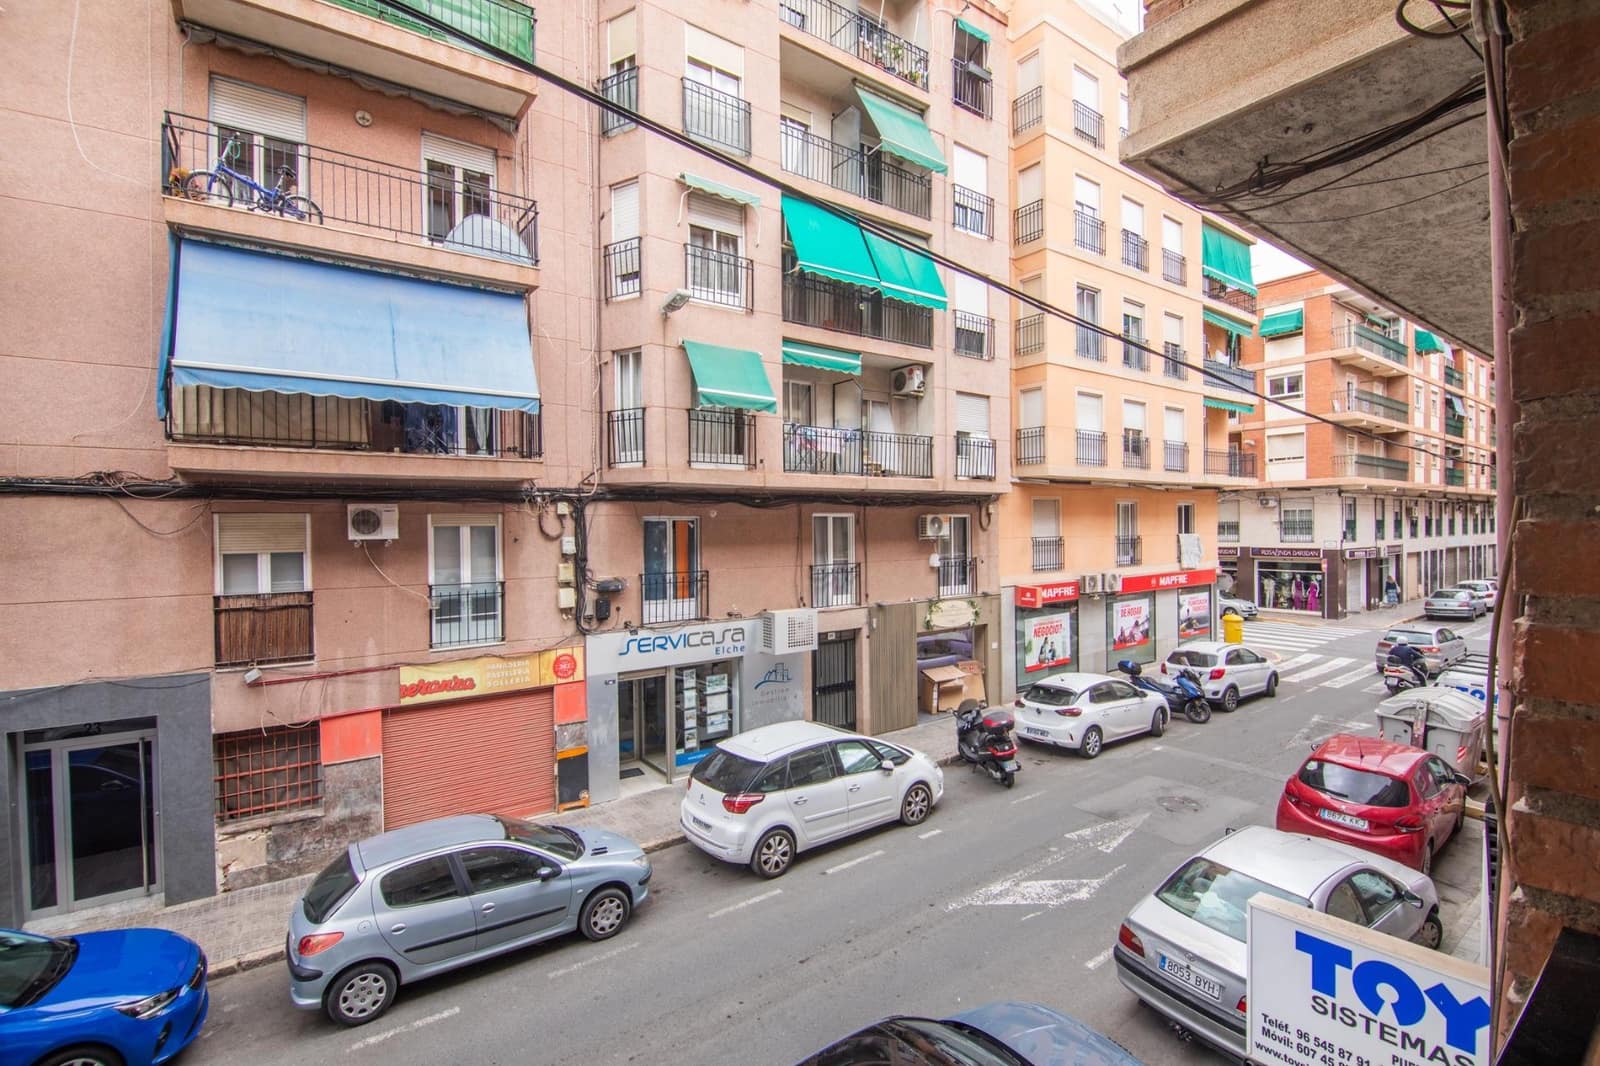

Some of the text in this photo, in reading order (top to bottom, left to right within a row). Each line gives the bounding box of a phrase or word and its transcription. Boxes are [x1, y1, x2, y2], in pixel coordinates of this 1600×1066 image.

[1159, 574, 1188, 586] MAPFRE
[714, 644, 745, 655] Elche
[83, 722, 102, 735] 23
[1167, 961, 1215, 994] 8053 BYH
[1295, 930, 1490, 1055] TOY
[1262, 1013, 1291, 1034] Teléf.
[1296, 1029, 1310, 1043] 96
[1314, 1036, 1335, 1054] 545
[1338, 1048, 1353, 1061] 87
[1262, 1026, 1293, 1049] Móvil:
[1296, 1042, 1317, 1059] 607
